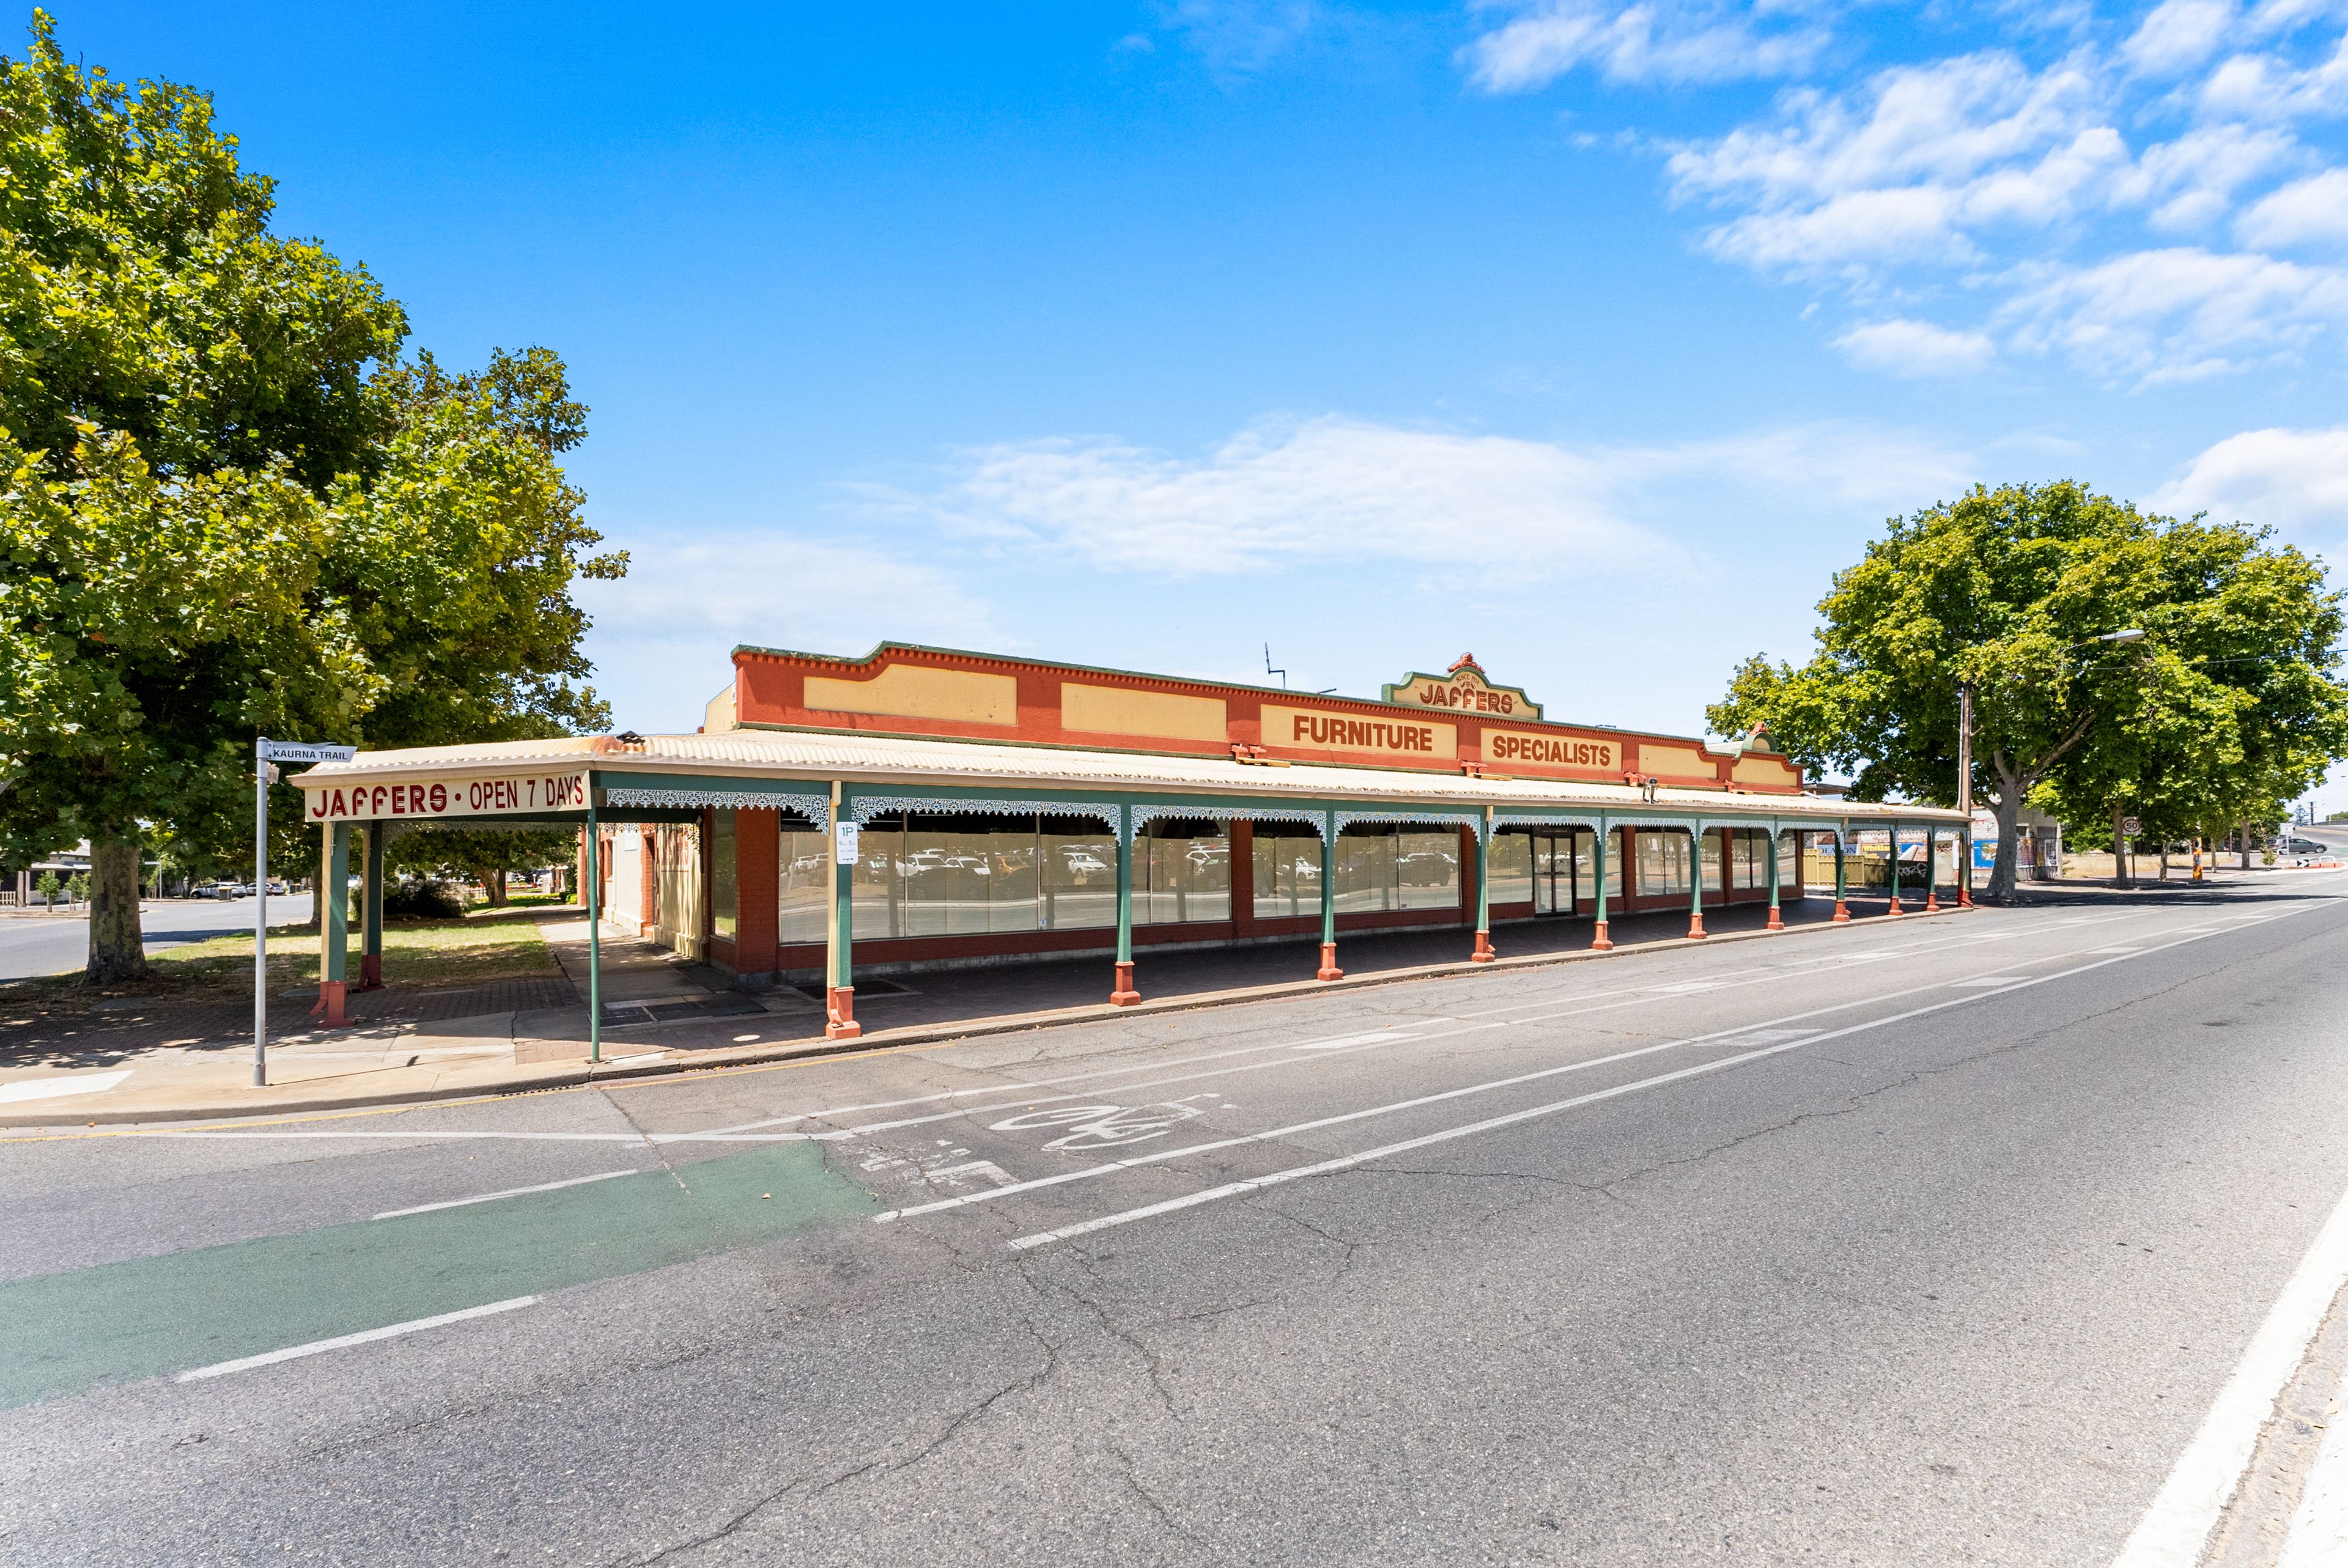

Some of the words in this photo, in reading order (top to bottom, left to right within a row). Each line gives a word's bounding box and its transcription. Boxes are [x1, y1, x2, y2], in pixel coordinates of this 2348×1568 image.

[1456, 674, 1470, 683] SINCE
[1420, 684, 1513, 714] JAFFERS
[1294, 715, 1432, 751] FURNITURE
[1493, 735, 1611, 767] SPECIALISTS
[273, 749, 316, 759] KAURNA
[319, 751, 348, 760] TRAIL
[312, 784, 447, 817] JAFFERS
[470, 780, 518, 810] OPEN
[527, 779, 536, 807] 7
[545, 775, 583, 806] DAYS
[841, 826, 854, 836] 1P
